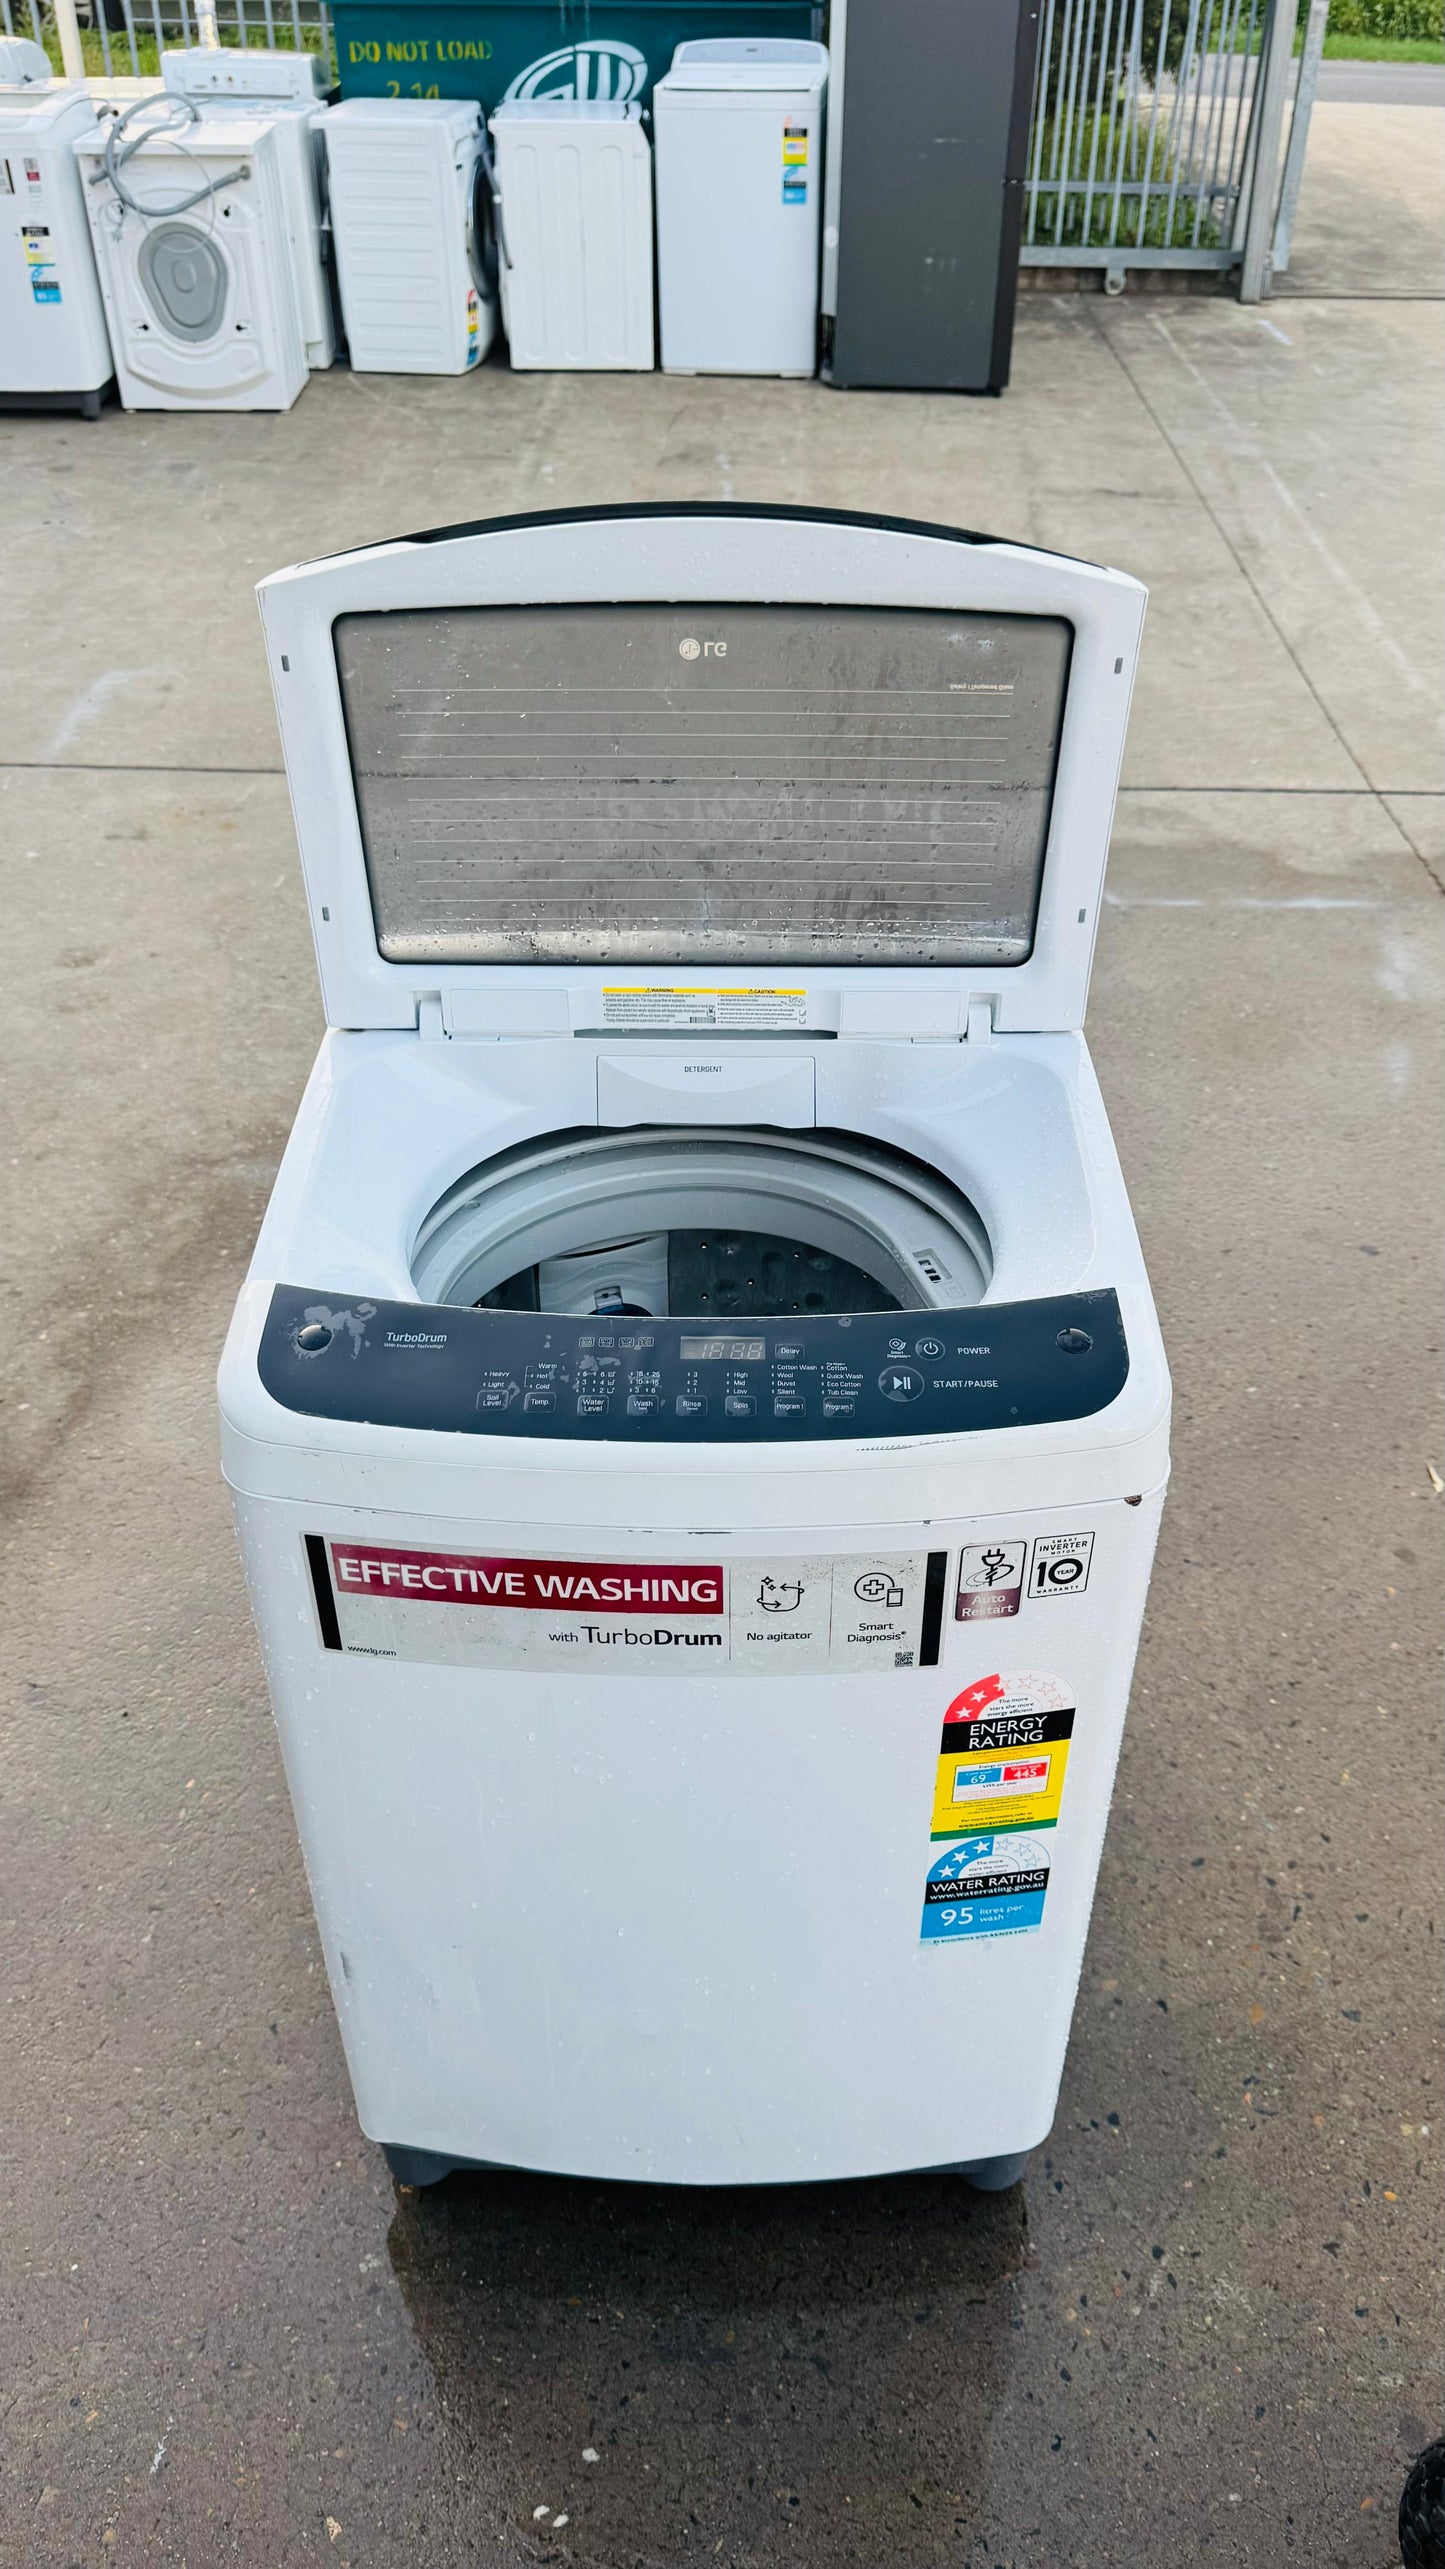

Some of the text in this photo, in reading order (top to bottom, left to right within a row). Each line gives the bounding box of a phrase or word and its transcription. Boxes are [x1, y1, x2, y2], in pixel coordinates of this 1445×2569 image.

[349, 40, 493, 63] DO NOT LOAD
[684, 1065, 722, 1073] DETERGENT
[386, 1331, 448, 1343] TurboDrum
[780, 1347, 801, 1355] Delay
[957, 1347, 991, 1355] POWER
[933, 1379, 999, 1389] START/PAUSE
[1039, 1540, 1088, 1552] INVERTER
[1036, 1558, 1083, 1585] 10
[338, 1558, 717, 1602] EFFECTIVE WASHING
[1036, 1585, 1079, 1594] WARRANTY
[971, 1595, 1006, 1605] Auto
[961, 1604, 1014, 1617] Restart
[858, 1622, 895, 1632] Smart
[549, 1626, 722, 1646] with TurboDrum
[746, 1632, 813, 1642] No agitator
[347, 1645, 397, 1656] www.lg.com
[970, 1716, 1048, 1736] ENERGY
[968, 1730, 1044, 1749] RATING
[970, 1774, 986, 1784] 69
[1013, 1767, 1038, 1779] 445
[931, 1871, 1045, 1893] WATER RATING
[929, 1882, 1044, 1900] www.waterrating.gov.au
[940, 1905, 1025, 1927] 95 litres per
[979, 1915, 1004, 1923] wash
